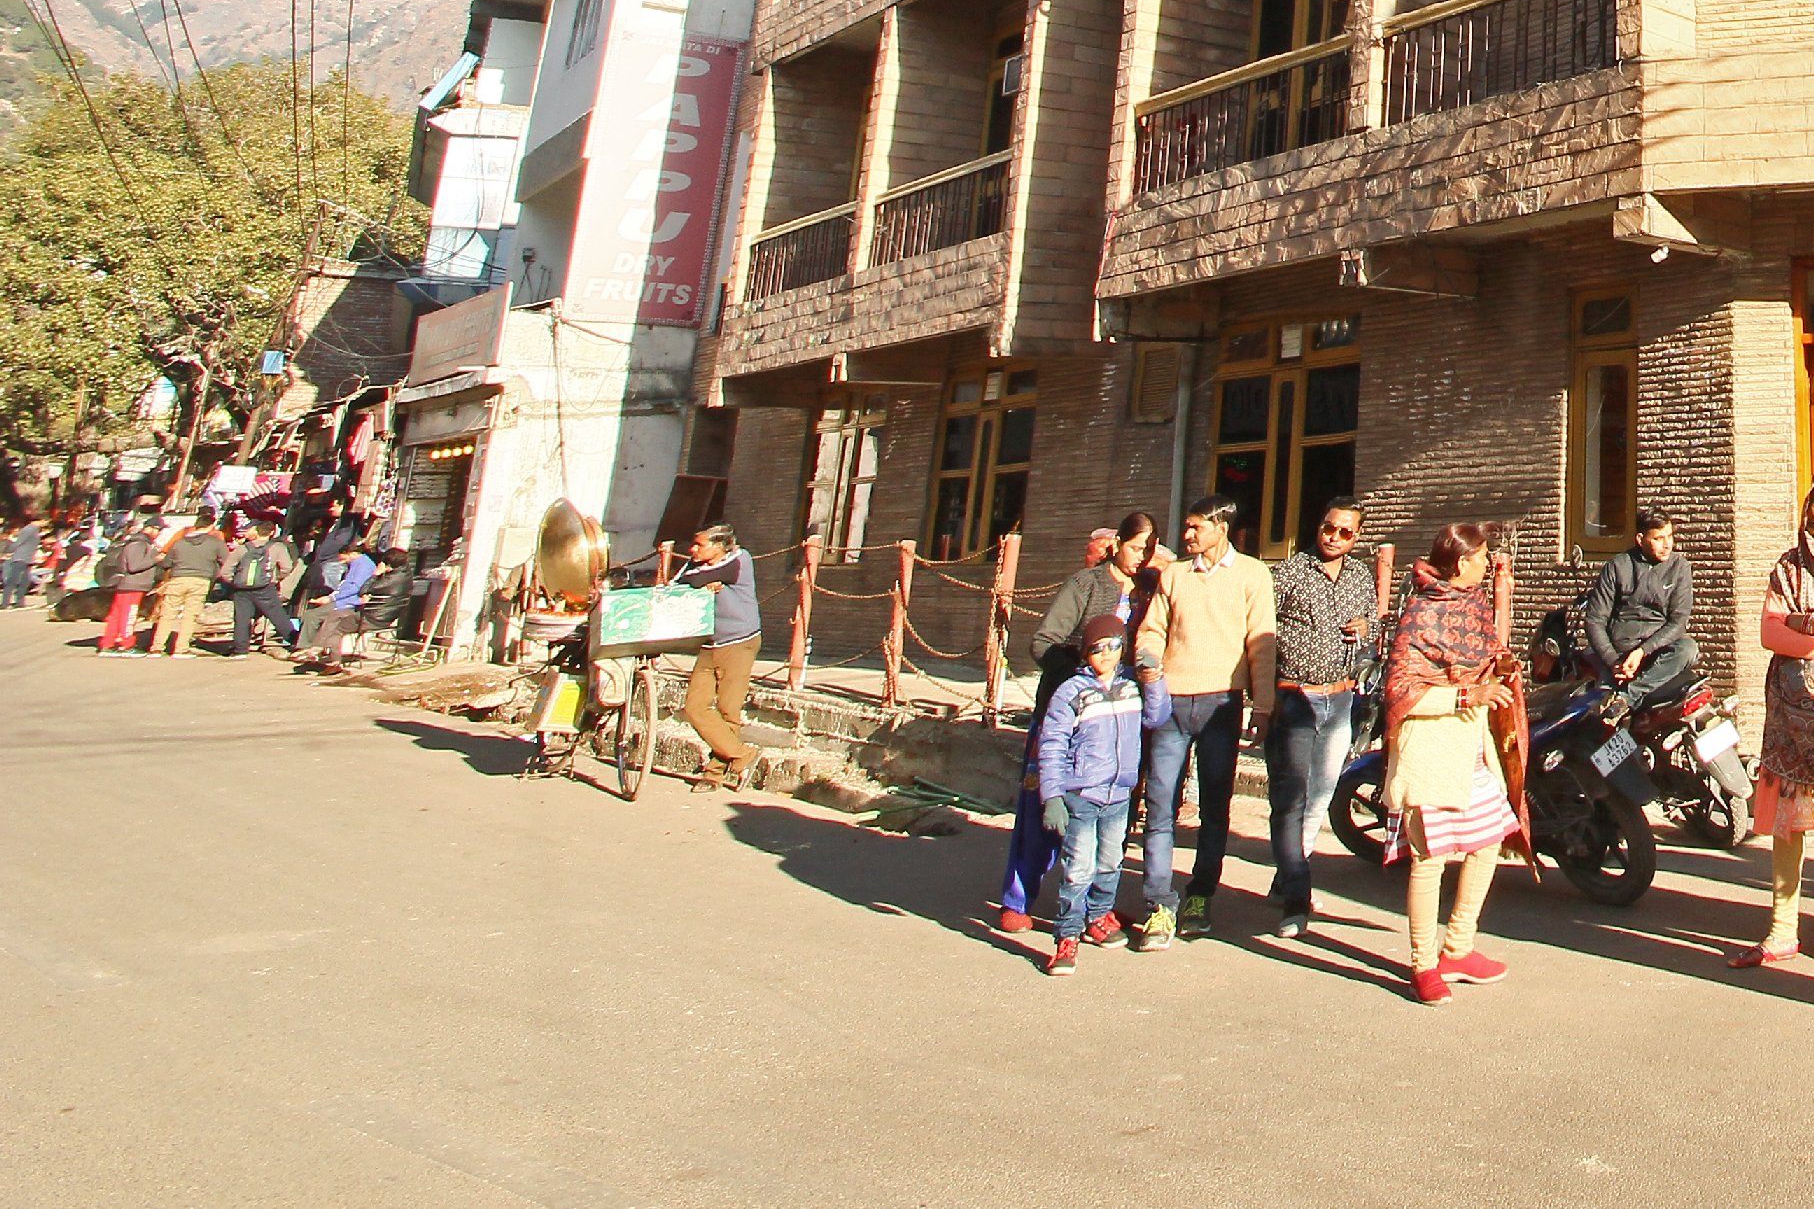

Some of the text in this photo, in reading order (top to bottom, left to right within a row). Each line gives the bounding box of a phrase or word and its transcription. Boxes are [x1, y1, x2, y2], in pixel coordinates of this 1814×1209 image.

[616, 53, 711, 243] PAPPU
[612, 252, 676, 278] DRY
[582, 280, 692, 306] FRUITS
